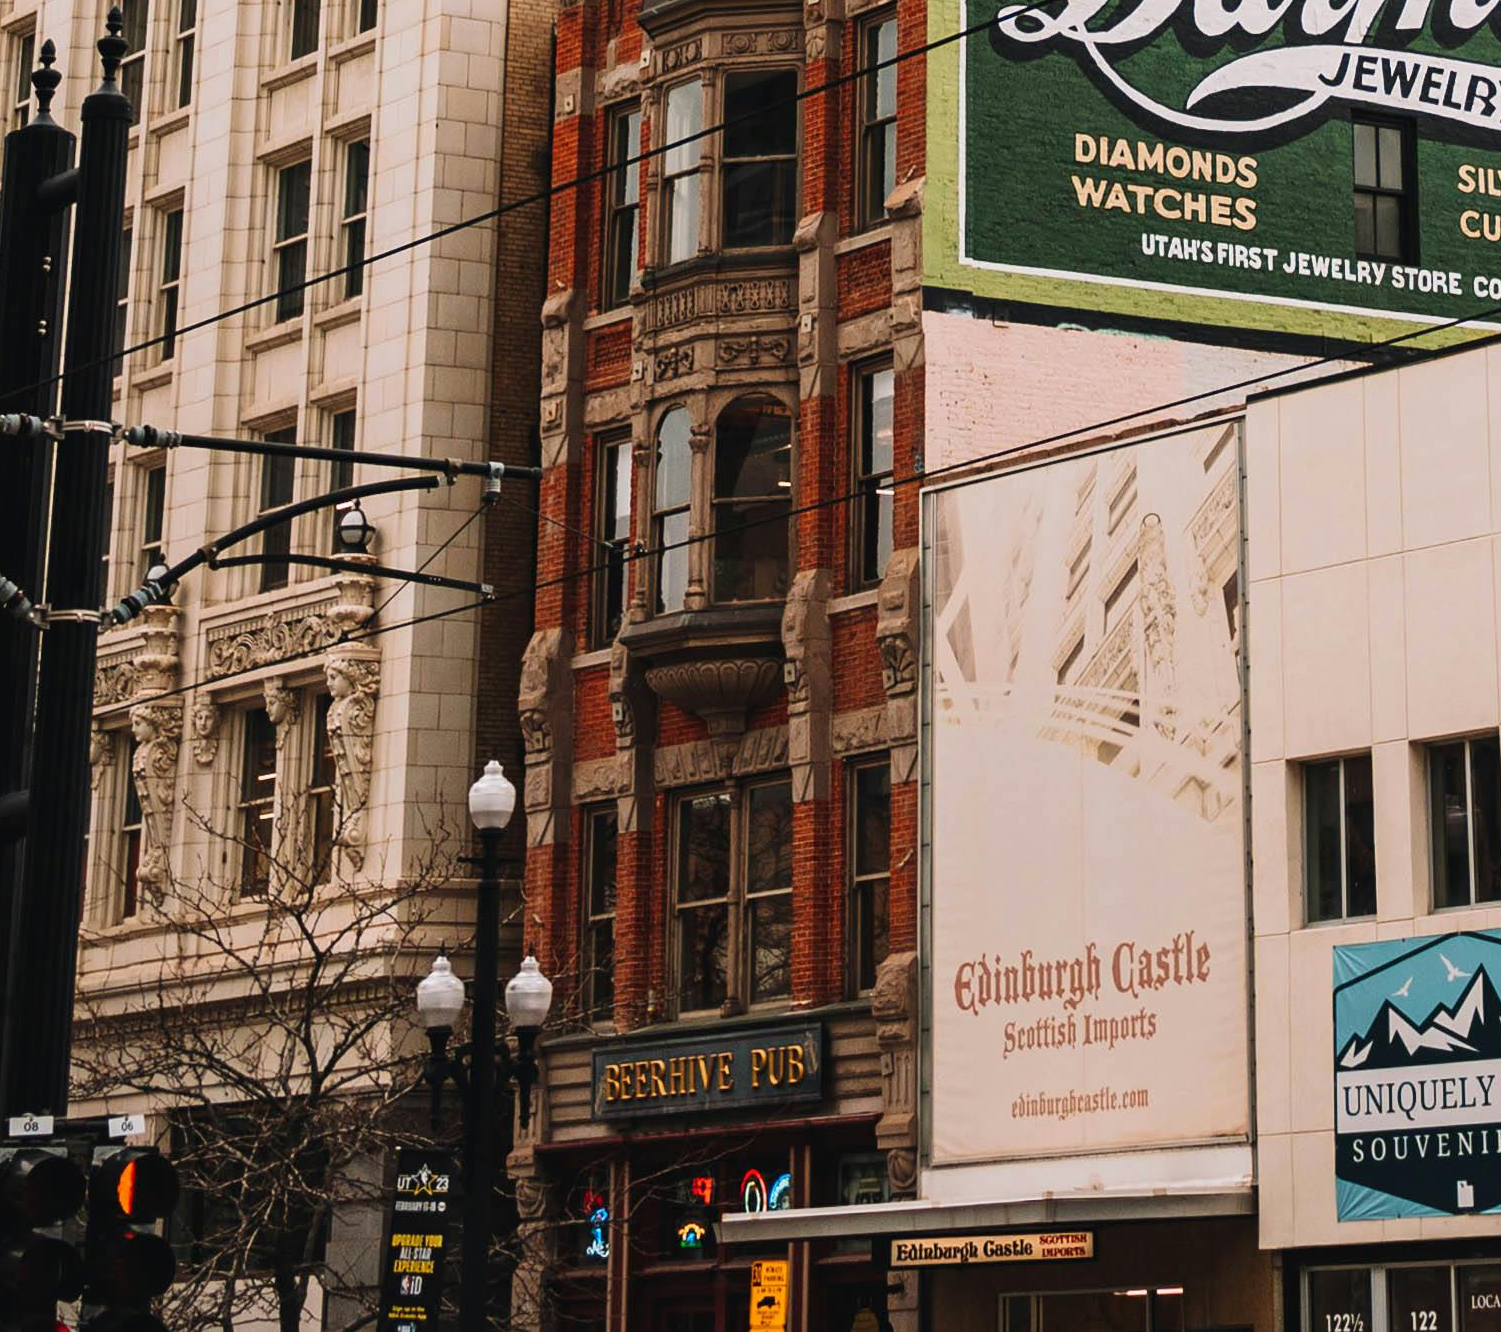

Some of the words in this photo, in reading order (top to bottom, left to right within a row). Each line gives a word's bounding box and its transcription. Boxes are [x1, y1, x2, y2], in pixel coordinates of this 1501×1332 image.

[1074, 133, 1258, 188] DIAMONDS
[1071, 175, 1258, 230] WATCHES
[1142, 233, 1214, 263] UTAH'S
[1217, 242, 1278, 271] FIRST
[1283, 251, 1386, 285] JEWELRY
[1392, 265, 1462, 296] STORE
[954, 942, 1101, 1016] Edinburgh
[1112, 930, 1211, 999] Castle
[1003, 1014, 1077, 1060] Scottish
[1083, 1007, 1157, 1050] Imports
[605, 1052, 734, 1102] BEERHIVE
[751, 1045, 804, 1088] PUB
[1011, 1087, 1149, 1121] edinburghcastle.com
[1343, 1074, 1495, 1121] UNIQUELY
[23, 1121, 39, 1132] 08
[121, 1121, 134, 1132] 06
[397, 1176, 412, 1190] UT
[435, 1177, 449, 1190] 23
[896, 1240, 979, 1263] Edinburgh
[983, 1238, 1033, 1258] Castle
[1039, 1233, 1087, 1246] SCOTTISH
[1042, 1246, 1086, 1258] IMPORTS
[394, 1261, 435, 1273] EXPERIENCE
[1411, 1311, 1437, 1332] 122
